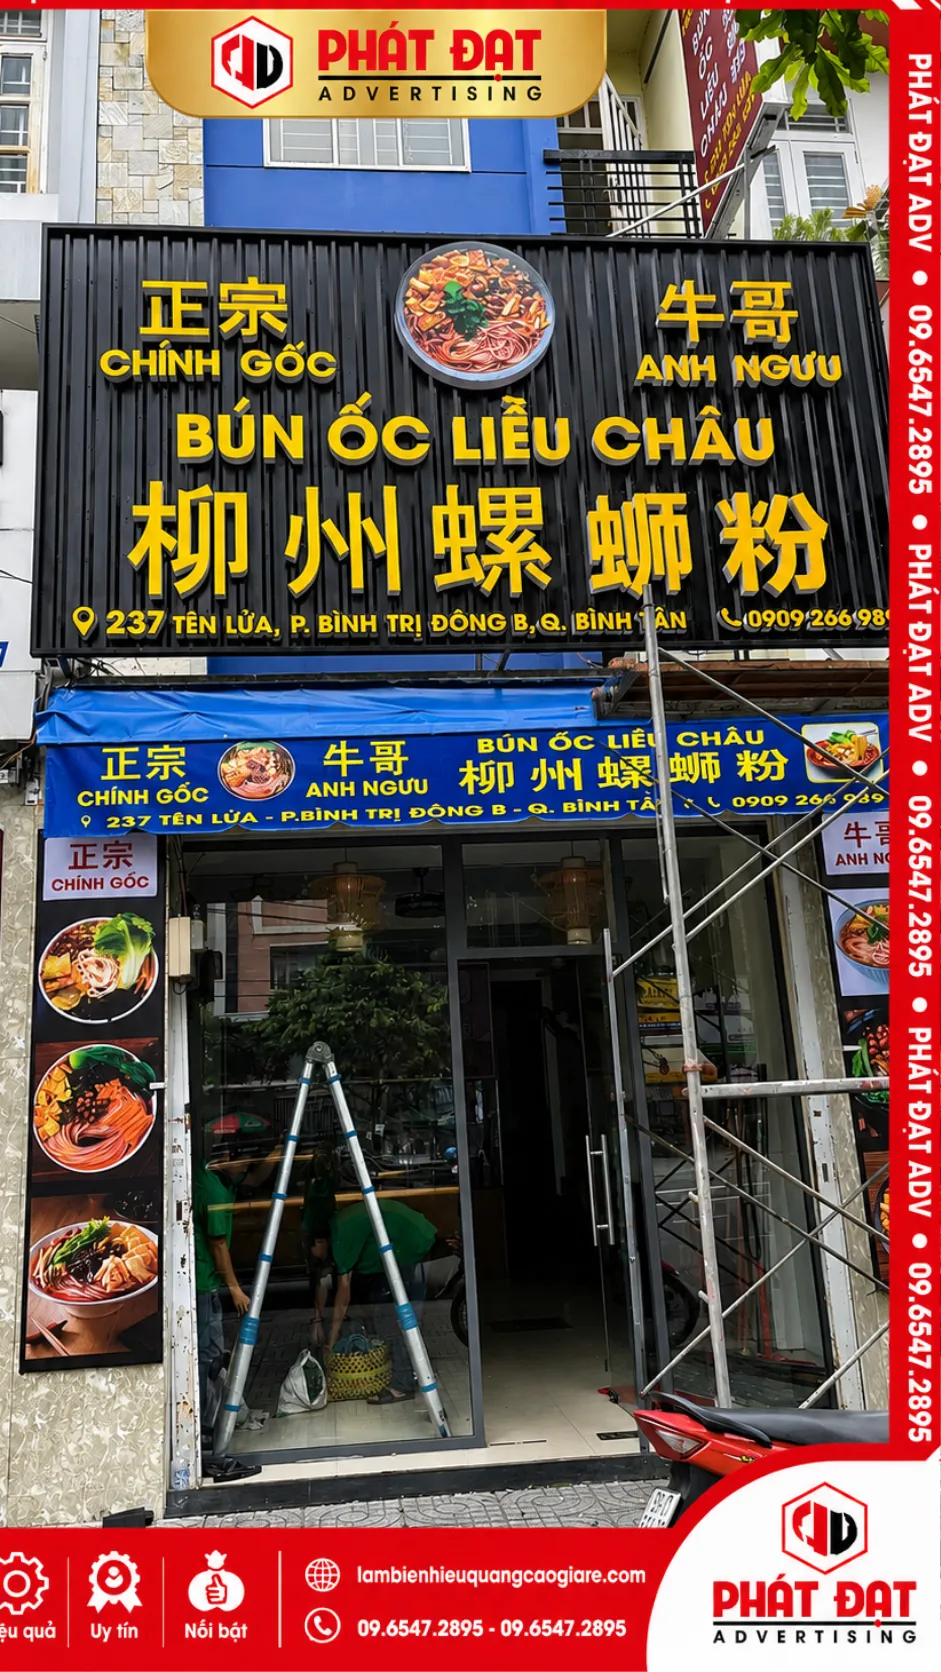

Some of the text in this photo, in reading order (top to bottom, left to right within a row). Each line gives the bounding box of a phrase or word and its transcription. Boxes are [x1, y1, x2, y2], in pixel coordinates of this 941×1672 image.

[139, 276, 288, 337] 正宗
[658, 280, 798, 343] 牛哥
[100, 339, 337, 377] CHÍNH GỐC
[636, 350, 842, 382] ANH NGƯU
[177, 391, 775, 461] BÚN ỐC LIỄU CHÂU
[128, 481, 828, 596] 柳州螺蛳粉
[106, 610, 165, 635] 237
[172, 611, 216, 634] TÊN
[226, 608, 280, 638] LỬA,
[291, 615, 309, 633] P.
[319, 609, 377, 633] BÌNH
[387, 614, 421, 638] TRỊ
[431, 608, 507, 631] ĐÔNG
[576, 608, 632, 631] BÌNH
[749, 609, 804, 627] 0909
[811, 609, 853, 626] 266
[477, 733, 538, 754] BÚN
[548, 731, 595, 751] ỐC
[677, 726, 764, 747] CHÂU
[101, 745, 186, 781] 正宗
[323, 740, 408, 778] 牛哥
[78, 783, 208, 807] CHÍNH GỐC
[306, 779, 428, 797] ANH NGƯU
[732, 795, 788, 808] 0909
[107, 815, 151, 828] 237
[159, 811, 203, 825] TÊN
[366, 808, 401, 823] TRỊ
[409, 803, 484, 818] ĐÔNG
[492, 804, 507, 815] B
[528, 803, 555, 815] Q.
[563, 799, 620, 813] BÌNH
[69, 841, 133, 870] 正宗
[836, 853, 868, 866] ANH
[51, 871, 149, 892] CHÍNH GỐC
